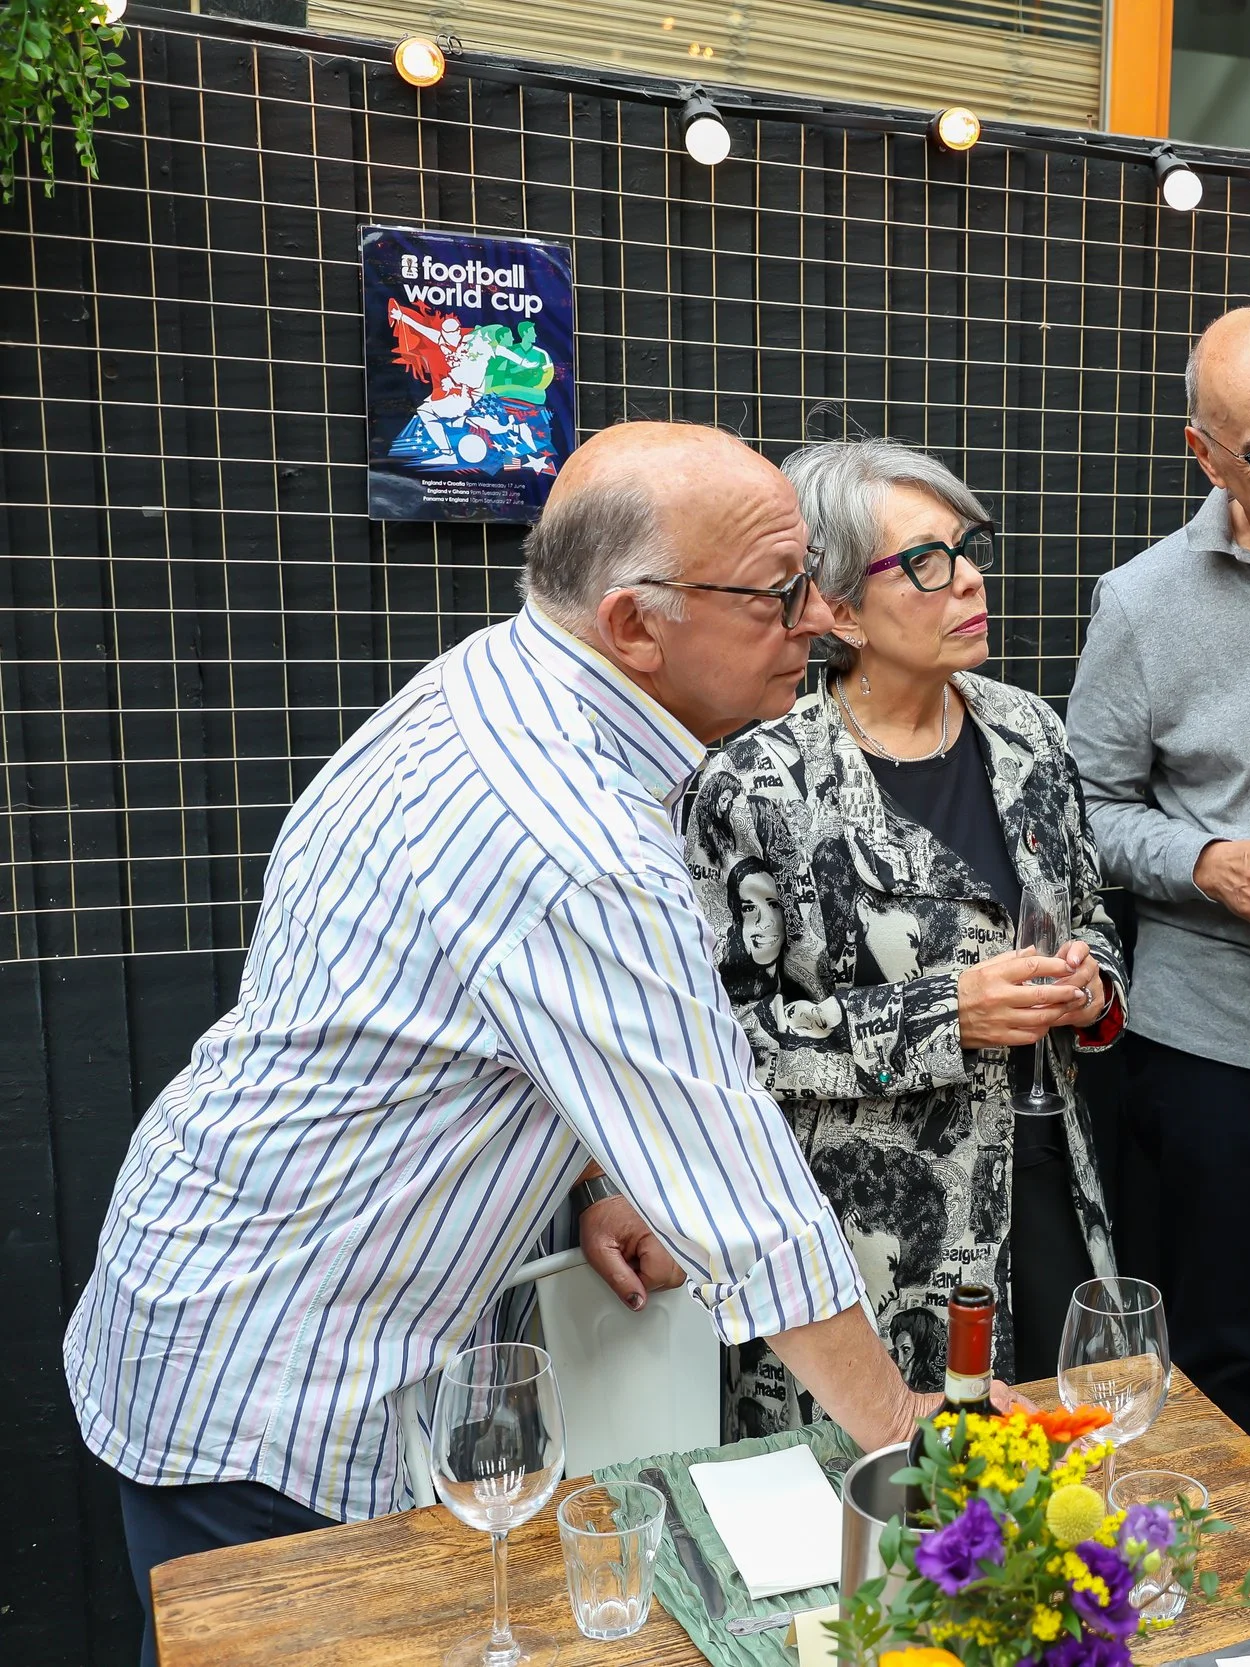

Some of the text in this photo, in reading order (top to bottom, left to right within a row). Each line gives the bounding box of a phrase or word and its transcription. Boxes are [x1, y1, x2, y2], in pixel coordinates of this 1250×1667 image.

[422, 255, 525, 289] football
[403, 282, 543, 319] world cup
[477, 481, 507, 489] Wednesday
[482, 489, 502, 497] Tuesday
[753, 1381, 787, 1402] made
